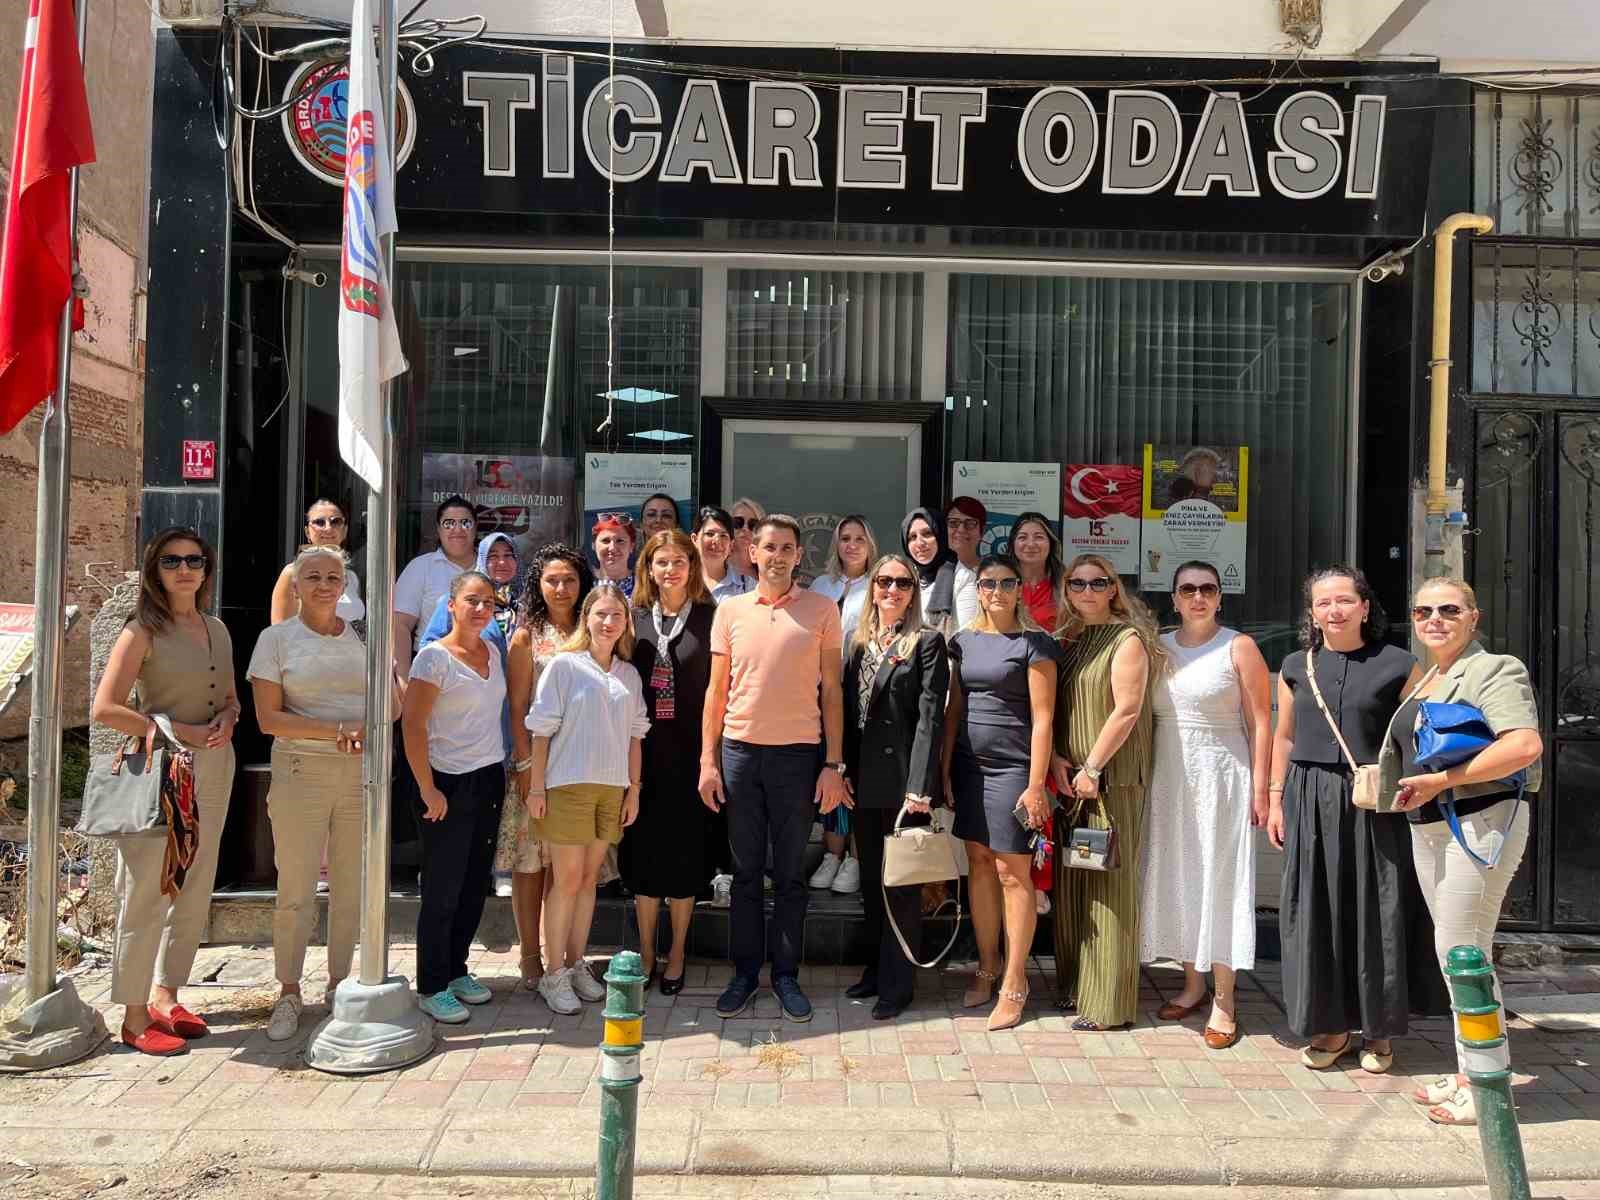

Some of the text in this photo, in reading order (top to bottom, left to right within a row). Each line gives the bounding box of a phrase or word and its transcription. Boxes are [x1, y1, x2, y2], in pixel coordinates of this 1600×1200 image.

[462, 53, 1388, 200] TİCARET ODASI
[521, 495, 564, 506] YAZILDI!
